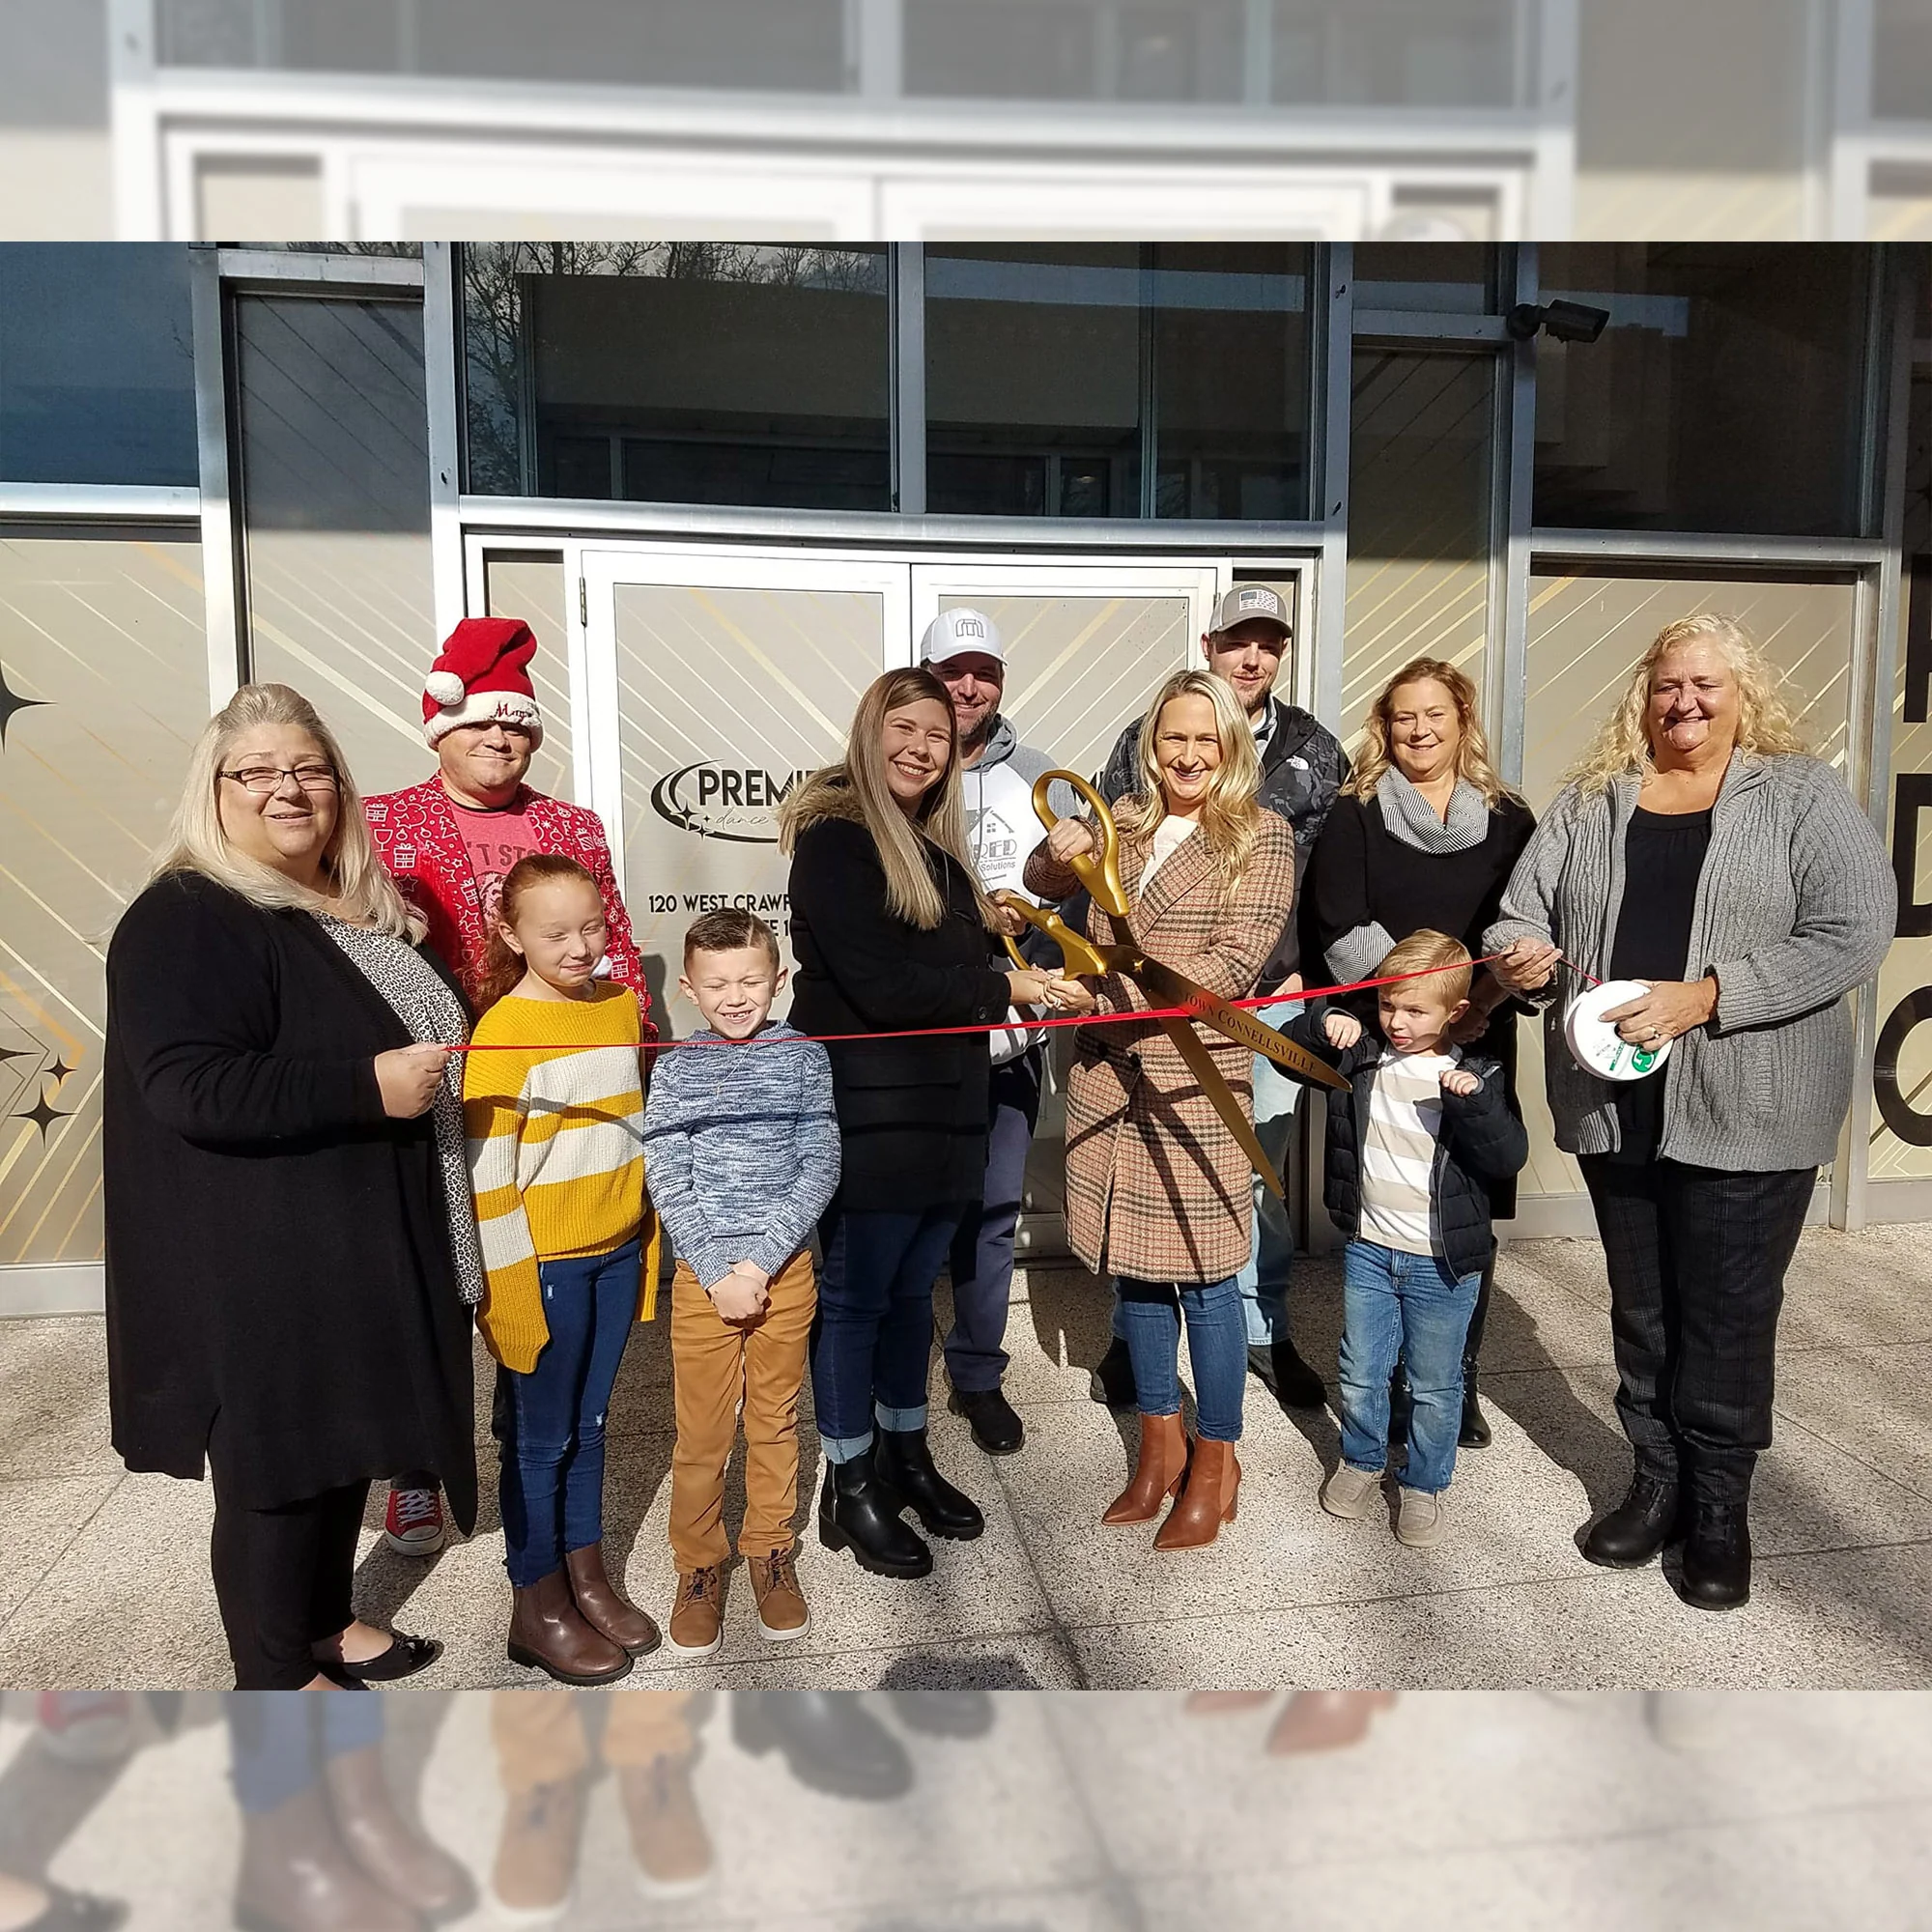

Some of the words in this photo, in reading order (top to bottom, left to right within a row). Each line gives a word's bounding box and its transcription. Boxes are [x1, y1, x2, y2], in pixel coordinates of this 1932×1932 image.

[697, 769, 818, 808] PREM
[716, 807, 769, 831] dance
[980, 861, 1016, 872] Solutions
[648, 895, 677, 913] 120
[683, 894, 728, 912] WEST
